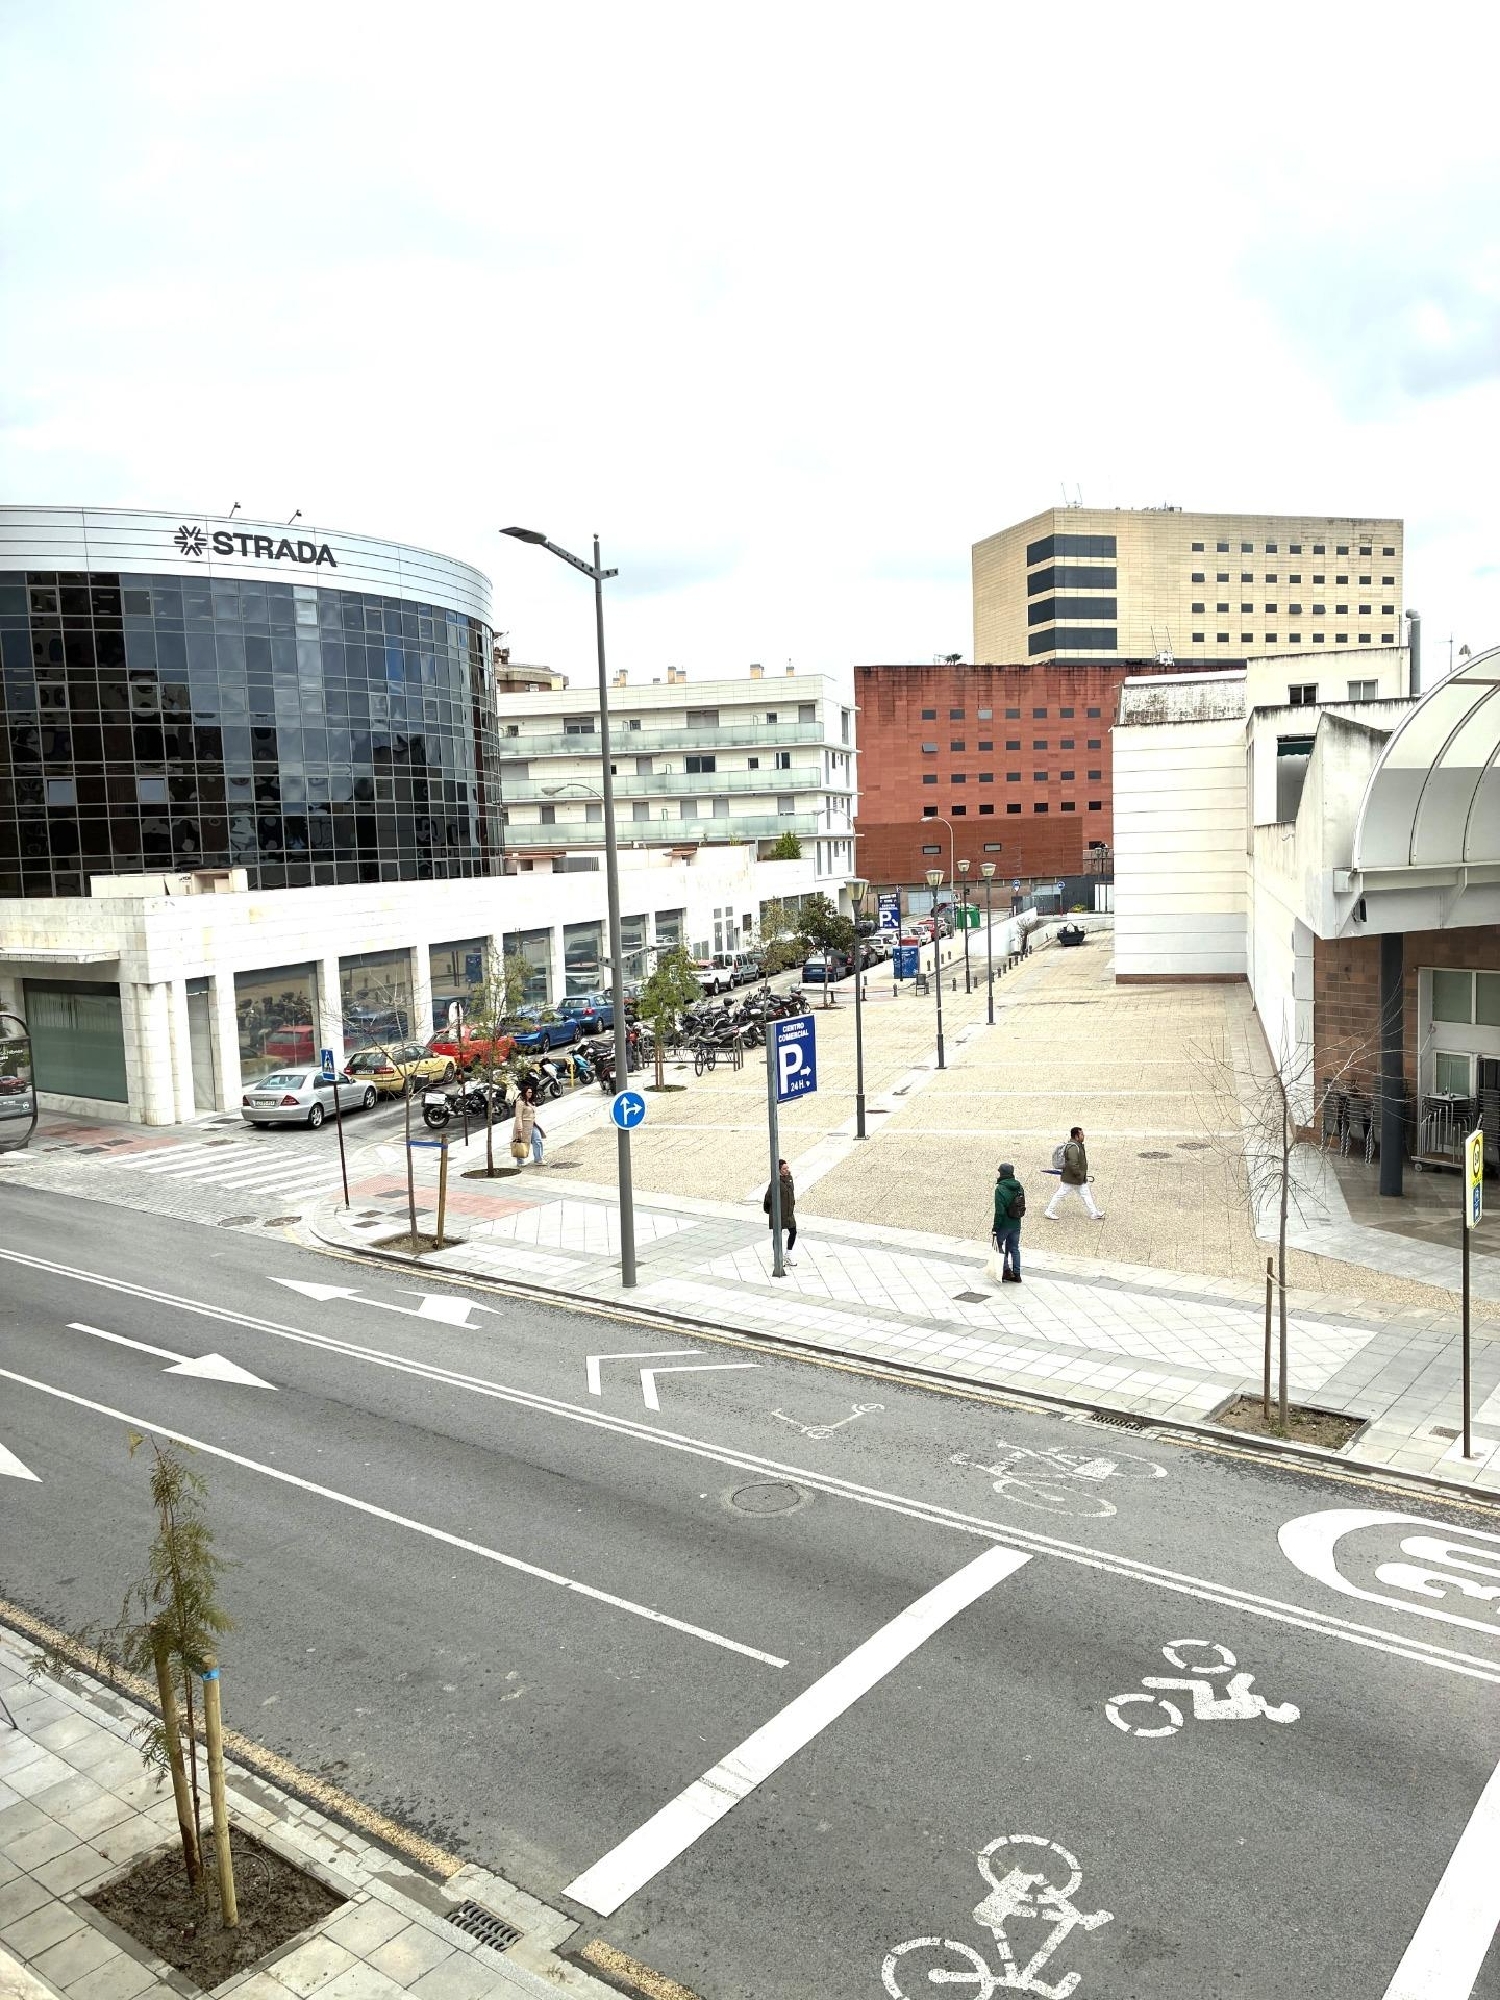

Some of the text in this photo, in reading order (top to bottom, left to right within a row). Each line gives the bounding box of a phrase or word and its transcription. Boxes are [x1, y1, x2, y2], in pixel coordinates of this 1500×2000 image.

[213, 531, 338, 567] STRADA
[879, 911, 892, 928] P
[778, 1029, 809, 1043] COMERCIAL
[779, 1043, 804, 1095] P
